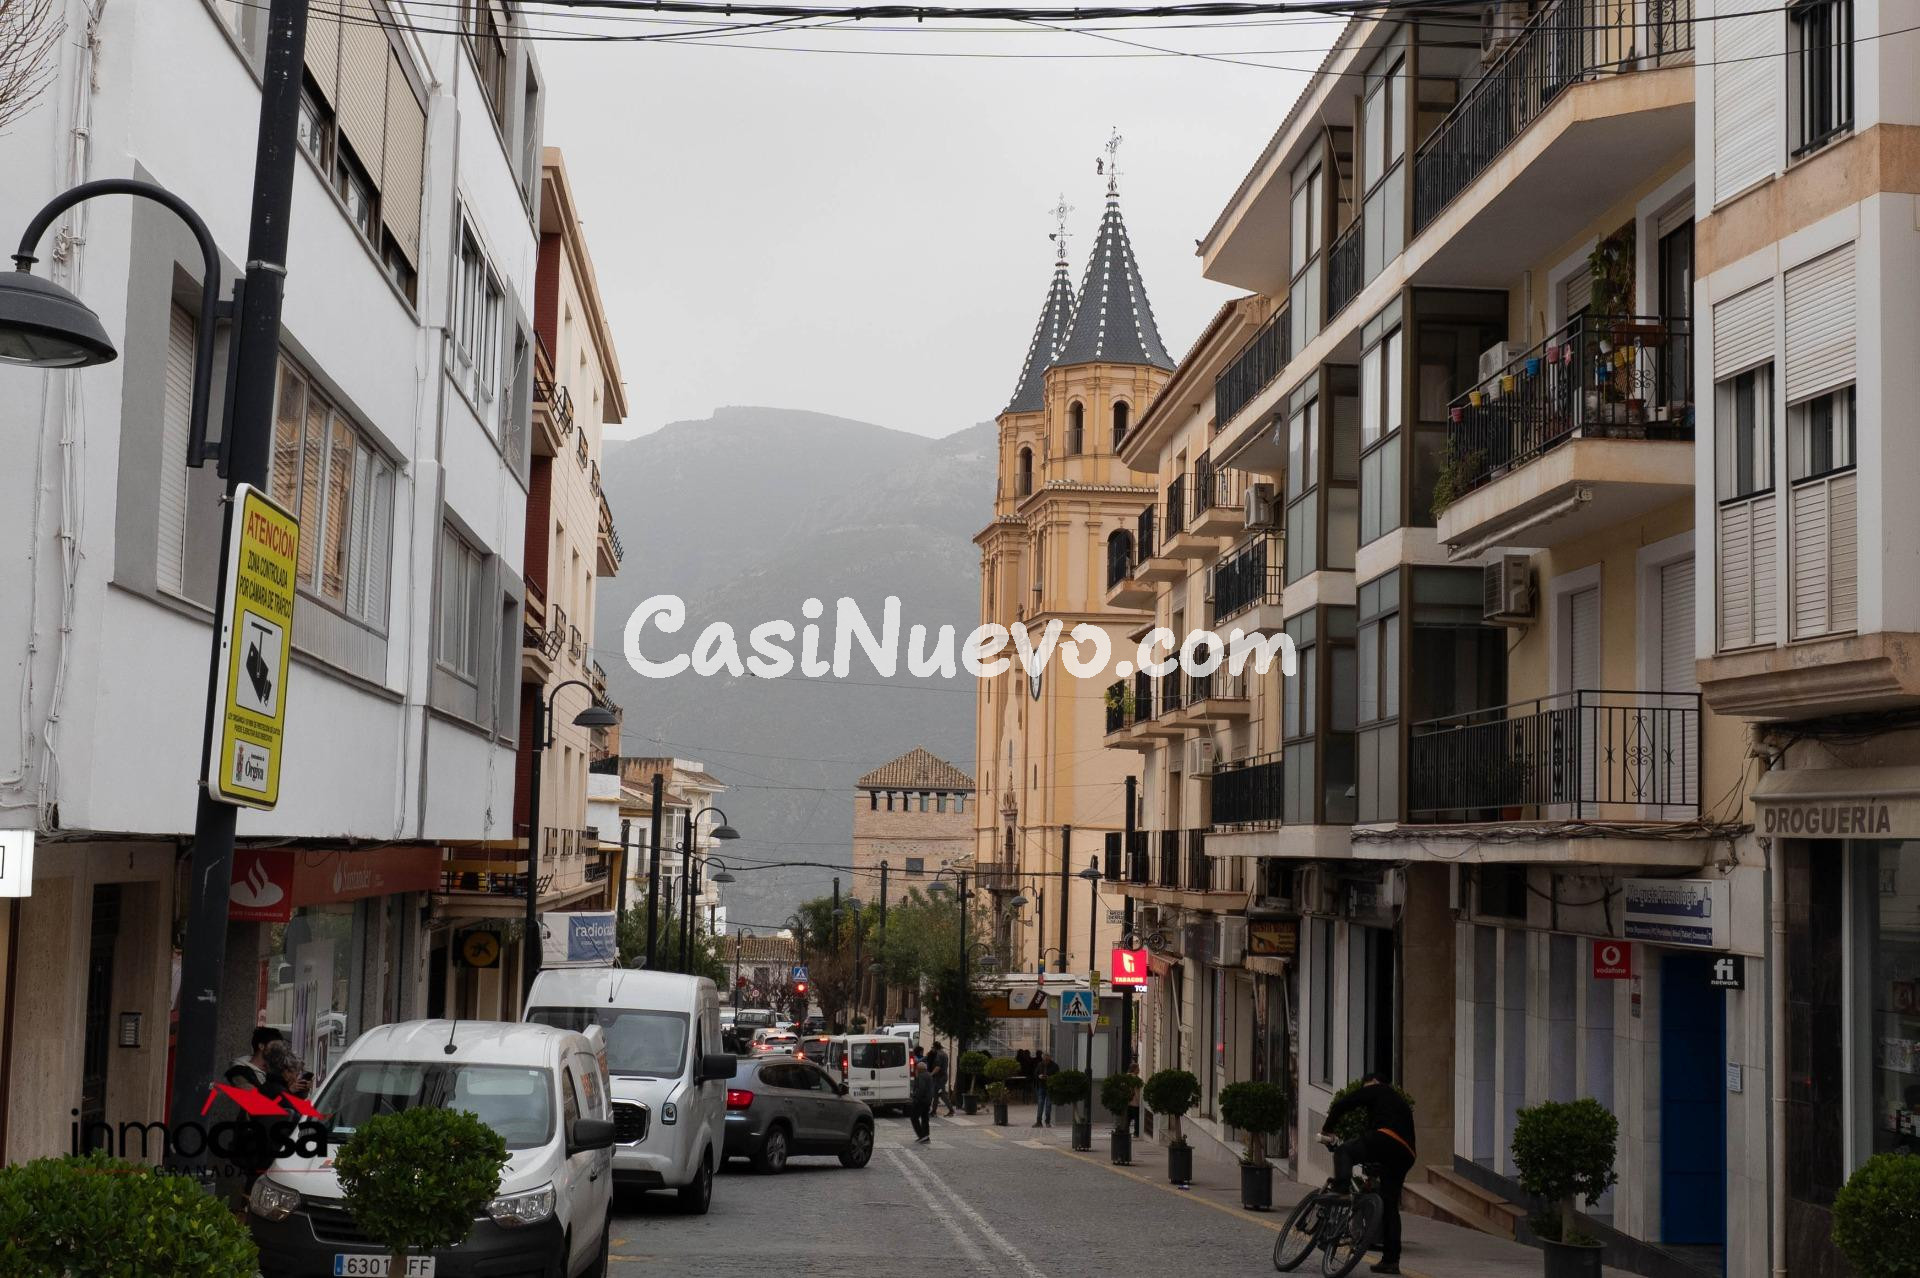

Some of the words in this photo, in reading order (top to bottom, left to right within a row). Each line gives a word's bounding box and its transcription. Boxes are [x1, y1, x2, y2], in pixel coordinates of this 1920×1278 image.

[247, 510, 296, 561] ATENCIÓN
[248, 550, 260, 574] ZONA
[260, 556, 288, 590] CONTROLADA
[239, 575, 249, 597] POR
[249, 578, 268, 608] CÁMARA
[267, 590, 275, 611] DE
[274, 592, 292, 619] TRÁFICO
[1765, 798, 1891, 834] DROGUERÍA
[1713, 958, 1734, 980] fi
